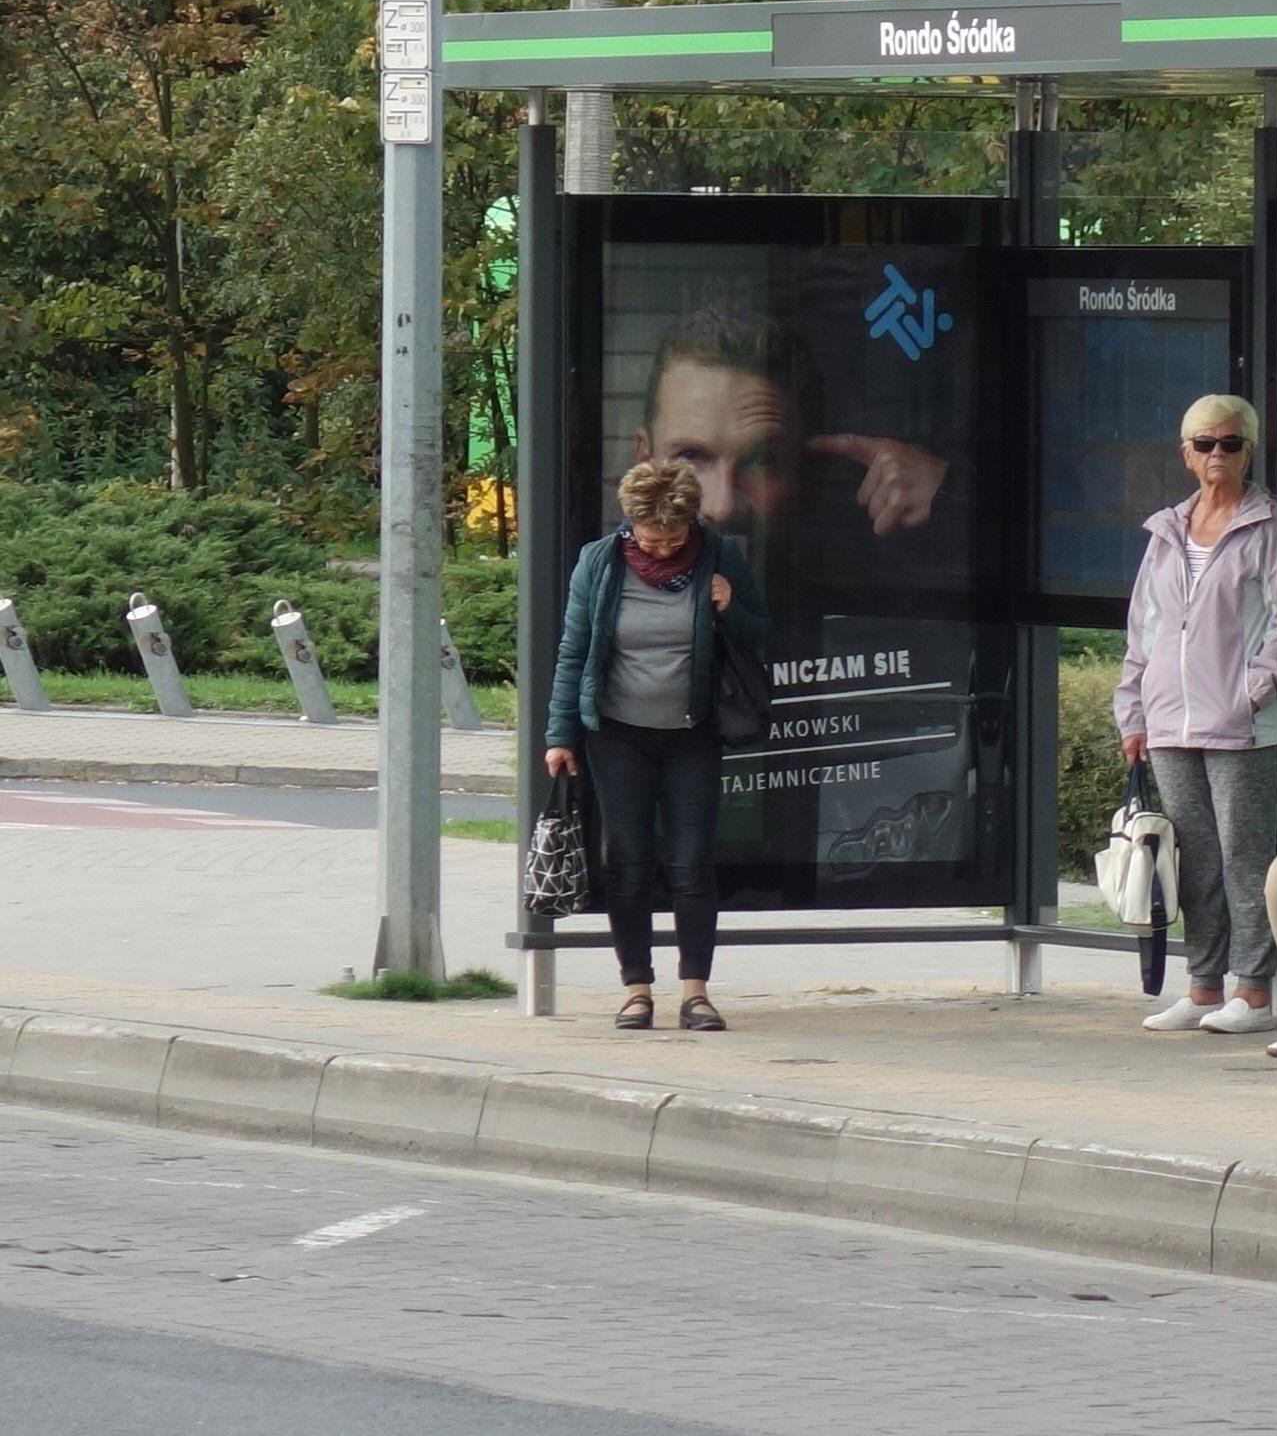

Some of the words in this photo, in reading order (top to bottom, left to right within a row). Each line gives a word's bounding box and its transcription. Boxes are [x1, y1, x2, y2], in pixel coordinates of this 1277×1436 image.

[385, 9, 399, 29] Z
[880, 21, 942, 56] Rondo
[946, 10, 1016, 55] Śródka
[385, 81, 399, 101] Z
[1079, 285, 1124, 310] Rondo
[1127, 279, 1177, 311] Śródka
[765, 654, 866, 687] NICZAM
[873, 649, 912, 679] SIĘ
[768, 714, 861, 740] AKOWSKI
[720, 760, 882, 795] TAJEMNICZENIE
